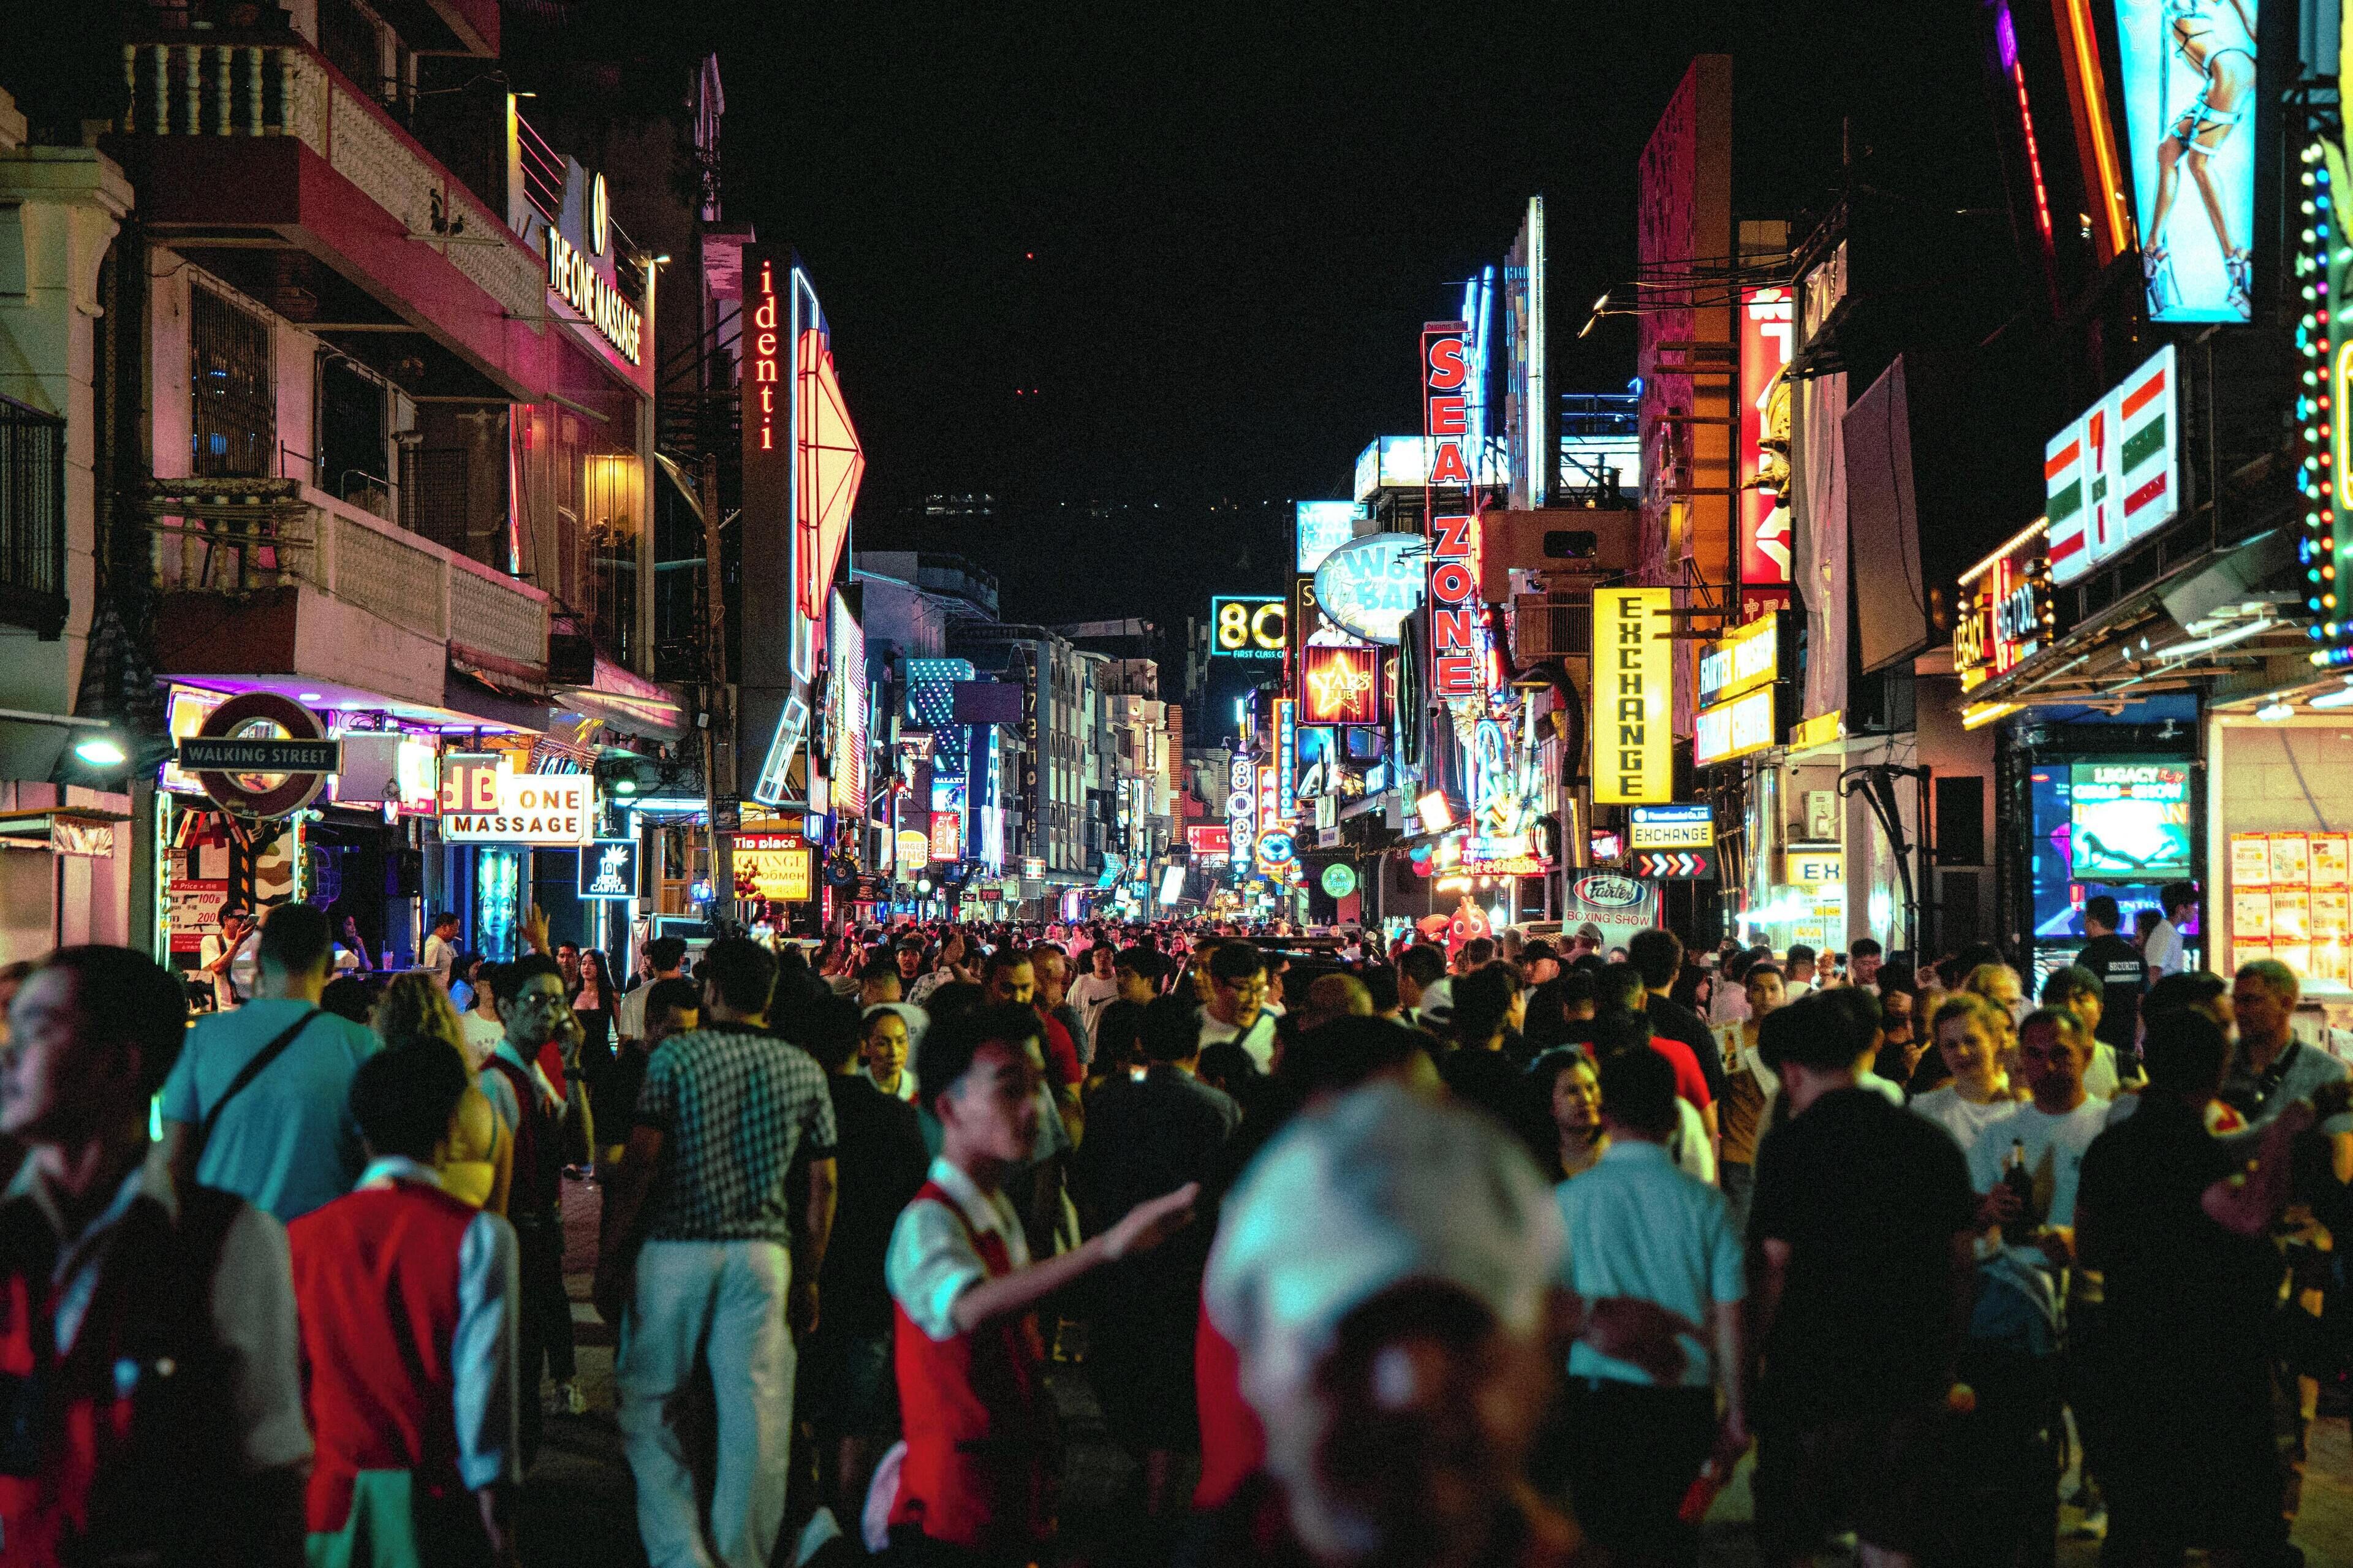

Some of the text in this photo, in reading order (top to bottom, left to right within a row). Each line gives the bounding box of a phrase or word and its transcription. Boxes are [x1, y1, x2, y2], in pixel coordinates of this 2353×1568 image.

[550, 226, 640, 366] THE ONE MASSAGE
[756, 262, 778, 449] identi
[1429, 338, 1470, 483] SEA
[1433, 515, 1476, 698] ZONE
[1233, 650, 1253, 659] FIRST
[1254, 650, 1275, 659] CLASS
[1309, 670, 1371, 691] STARS
[1327, 689, 1354, 700] CLUB
[1618, 597, 1644, 797] EXCHANGE
[1281, 702, 1294, 745] KING
[188, 746, 327, 763] WALKING STREET
[2094, 767, 2159, 783] LEGACY
[520, 790, 580, 809] ONE
[453, 815, 577, 833] MASSAGE
[733, 836, 797, 849] Tip place
[1635, 828, 1708, 842] EXCHANGE
[761, 869, 805, 881] обмен
[590, 884, 627, 893] CASTLE
[1327, 879, 1351, 889] Chang
[1590, 879, 1634, 901] Fairtex
[1567, 911, 1650, 926] BOXING SHOW
[2109, 961, 2140, 972] SECURITY
